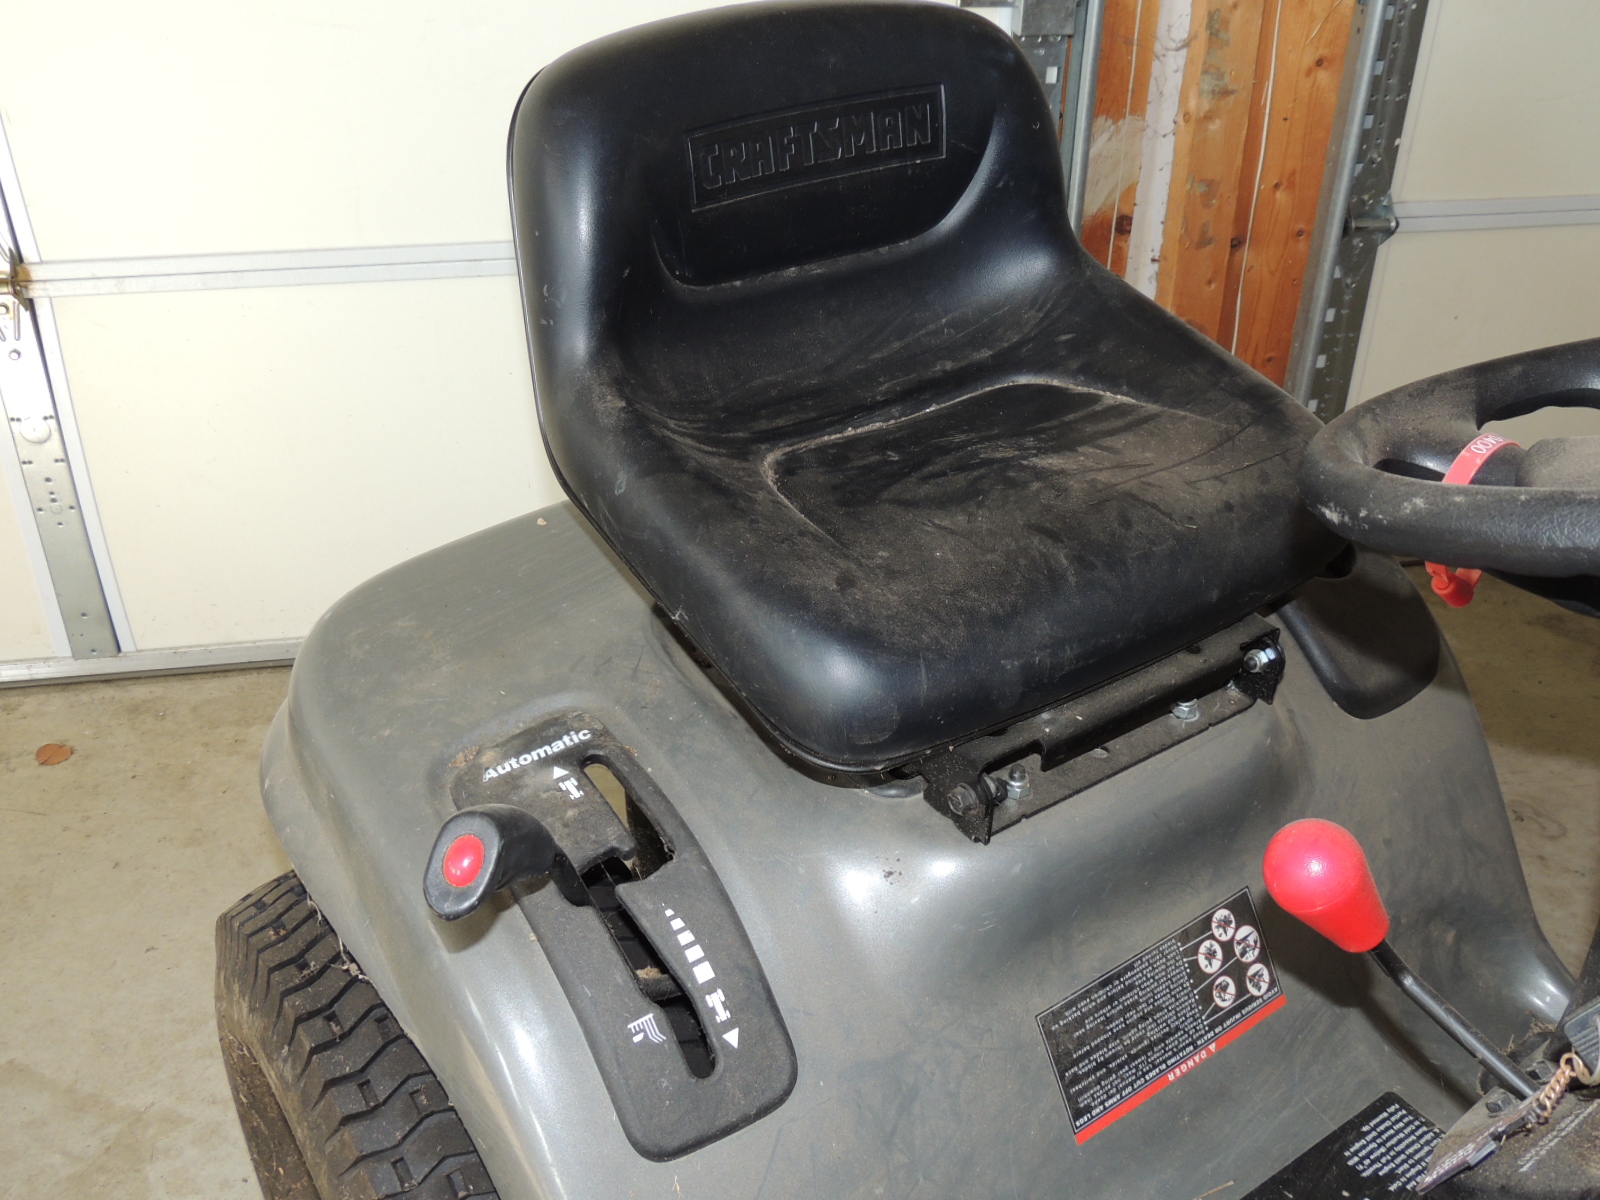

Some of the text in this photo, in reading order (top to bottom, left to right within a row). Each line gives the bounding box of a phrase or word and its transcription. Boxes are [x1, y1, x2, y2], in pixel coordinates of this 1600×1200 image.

[700, 103, 932, 190] CRAFTSMAN
[482, 729, 592, 782] Automatic
[1262, 986, 1279, 1002] AVOID
[1241, 996, 1264, 1016] SERIOUS
[1222, 1011, 1242, 1029] INJURY
[1196, 1029, 1215, 1047] DEATH
[1166, 1043, 1194, 1067] ROTATING
[1144, 1061, 1167, 1081] BLADES
[1166, 1048, 1208, 1082] DANGER
[1120, 1084, 1133, 1098] OFF
[1132, 1076, 1146, 1090] CUT
[1104, 1092, 1121, 1109] ARMS
[1385, 1103, 1401, 1114] Fully
[1091, 1103, 1105, 1117] AND
[1075, 1112, 1092, 1128] LEGS
[1391, 1121, 1405, 1131] May
[1401, 1114, 1414, 1124] You
[1348, 1109, 1408, 1153] Partial Choke Until Engine
[1380, 1128, 1396, 1140] Need
[1402, 1124, 1416, 1135] Cold
[1384, 1132, 1406, 1149] Weather
[1392, 1134, 1417, 1153] Smoothly
[1417, 1131, 1435, 1145] Adjust
[1357, 1141, 1379, 1158] Operate
[1404, 1142, 1421, 1155] Choke
[1380, 1154, 1391, 1164] Full
[1393, 1153, 1407, 1165] Until
[1377, 1162, 1396, 1176] Engine
[1404, 1164, 1423, 1179] Engine
